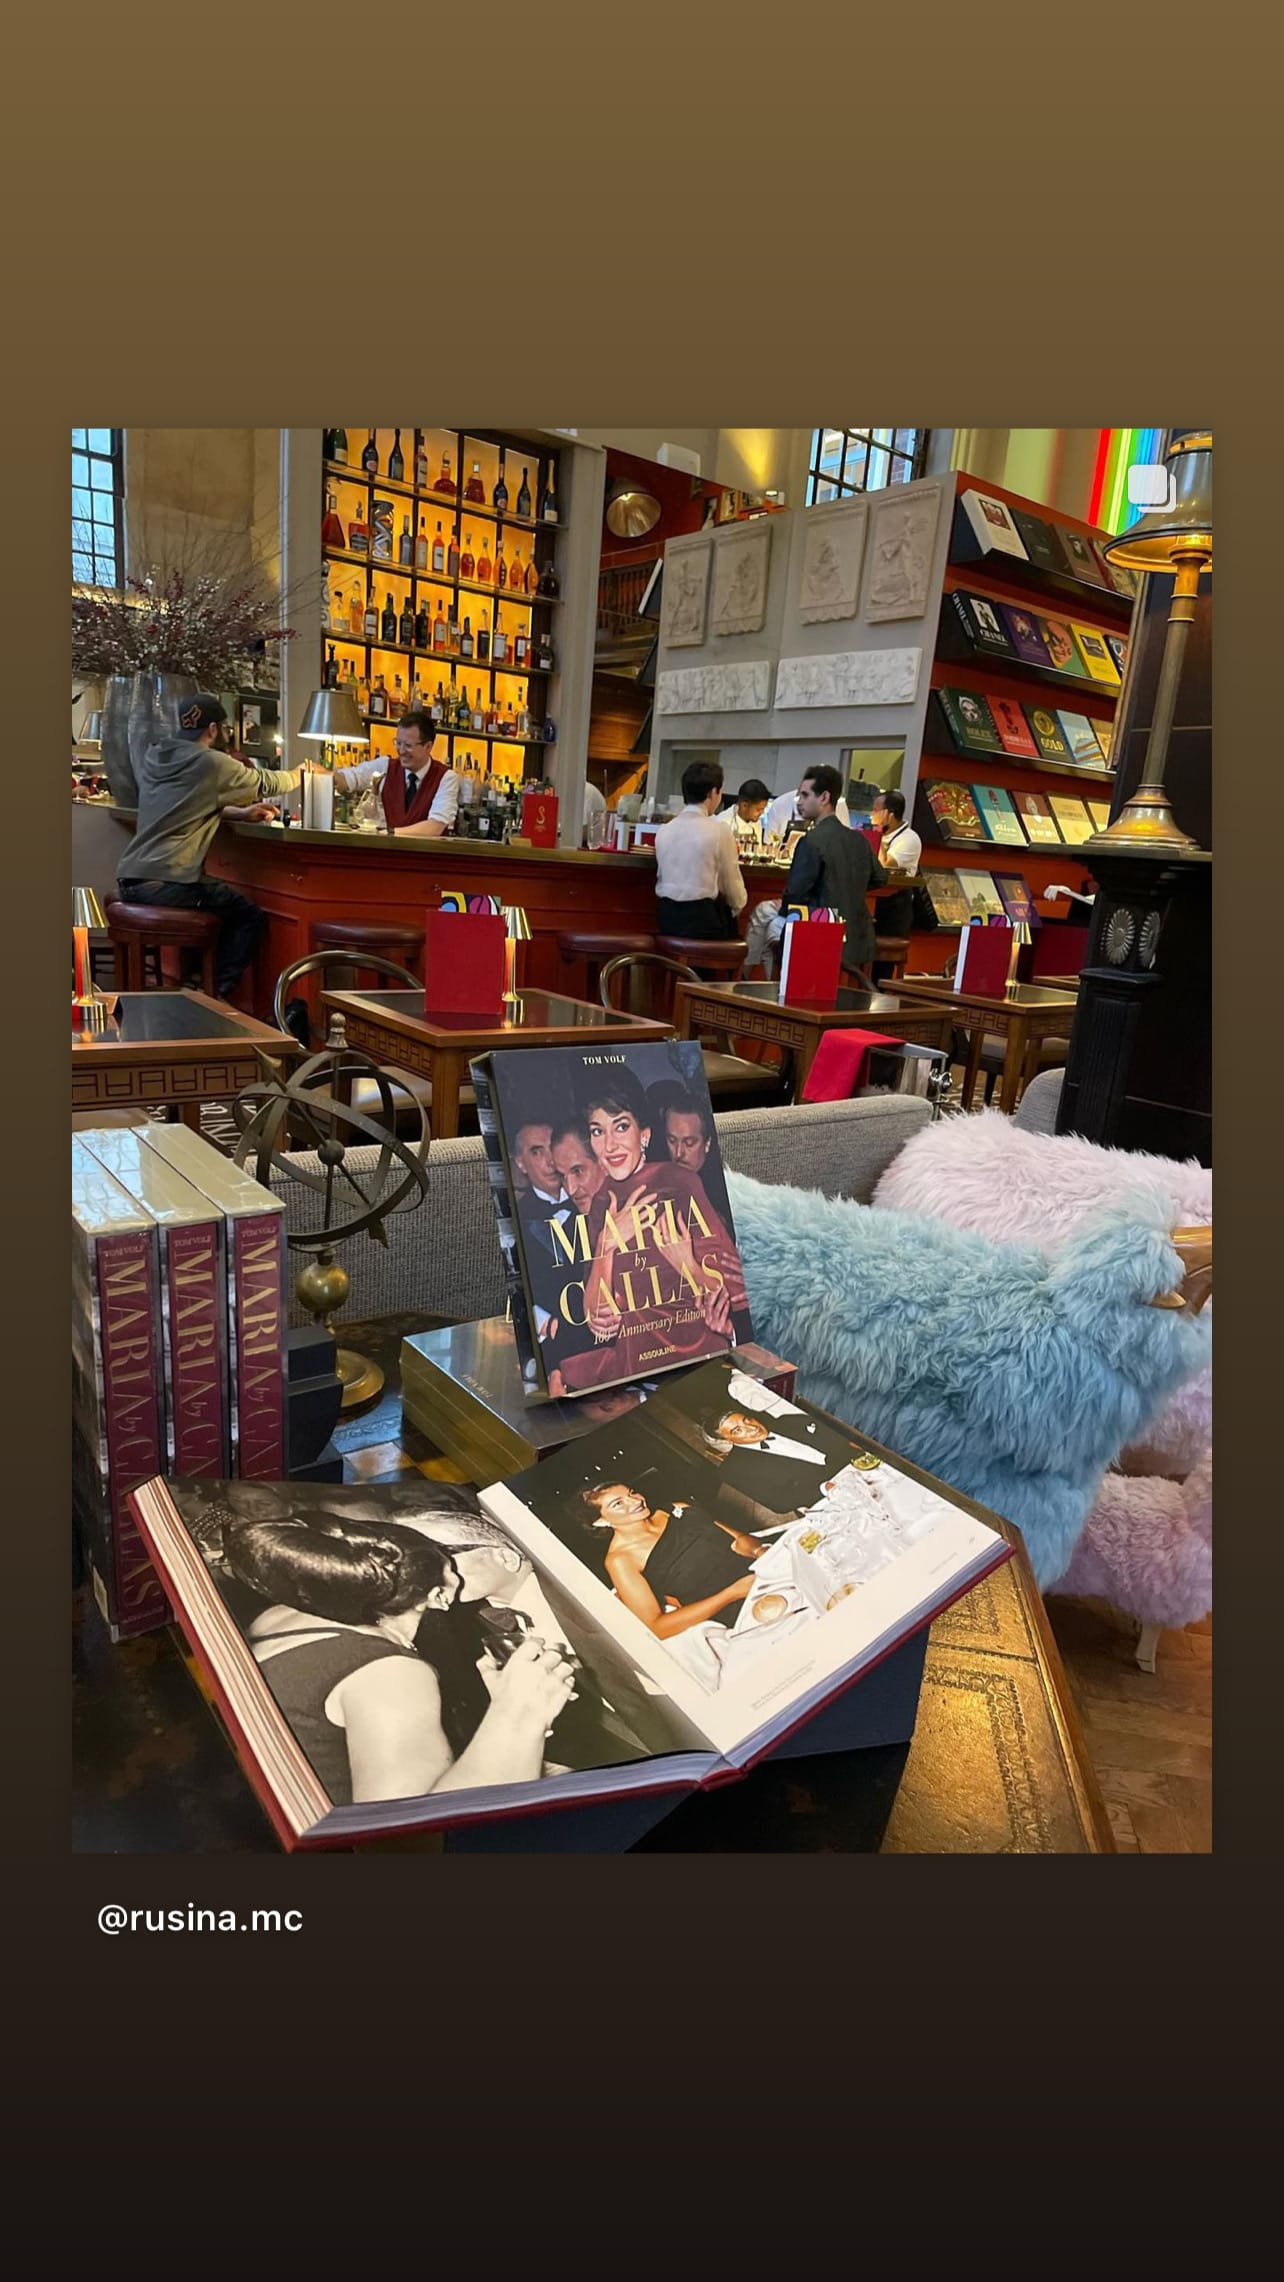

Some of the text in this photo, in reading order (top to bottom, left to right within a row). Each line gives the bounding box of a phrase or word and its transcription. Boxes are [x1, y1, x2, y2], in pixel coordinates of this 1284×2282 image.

[1040, 737, 1064, 751] GOLD
[582, 1055, 627, 1065] TOM VOLF
[543, 1195, 717, 1269] MARIA
[634, 1254, 647, 1271] by
[559, 1253, 725, 1327] CALLAS
[241, 1234, 279, 1393] MARIA
[174, 1245, 217, 1408] MARIA
[618, 1316, 673, 1339] Anniversary
[674, 1308, 706, 1325] Edition
[103, 1256, 152, 1420] MARIA
[638, 1345, 677, 1361] ASSOULINE
[250, 1387, 270, 1402] by
[184, 1402, 207, 1417] by
[118, 1417, 142, 1432] by
